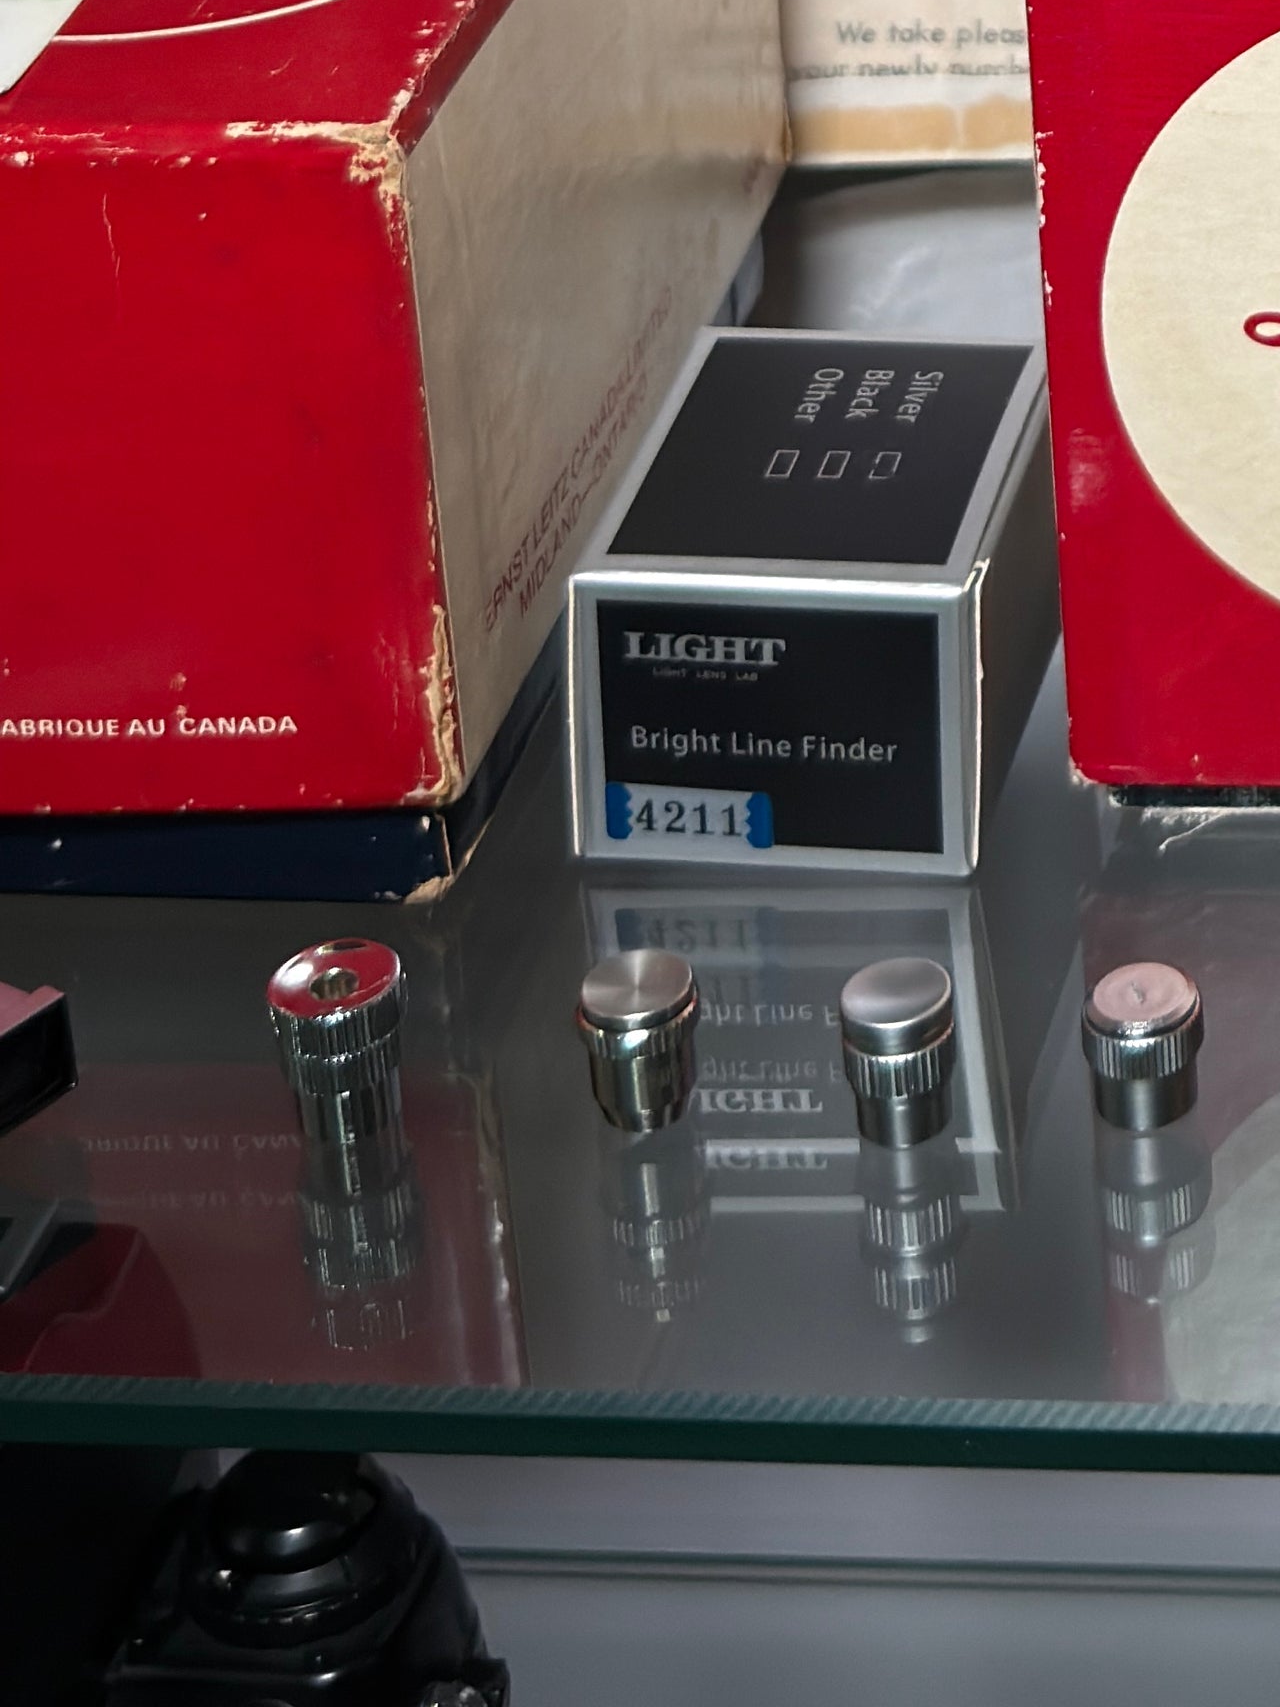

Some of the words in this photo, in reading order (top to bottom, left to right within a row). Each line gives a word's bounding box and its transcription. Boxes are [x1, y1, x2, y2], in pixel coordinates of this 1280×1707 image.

[836, 21, 877, 44] We
[889, 18, 947, 45] take
[794, 367, 845, 423] Other
[845, 368, 896, 420] Black
[899, 369, 944, 425] Silver
[533, 465, 569, 548] LEITZ
[622, 630, 787, 666] LIGHT
[128, 718, 167, 736] AU
[179, 715, 298, 735] CANADA
[631, 724, 721, 758] Bright
[731, 731, 792, 758] Line
[803, 734, 898, 763] Finder
[636, 798, 743, 837] 4211
